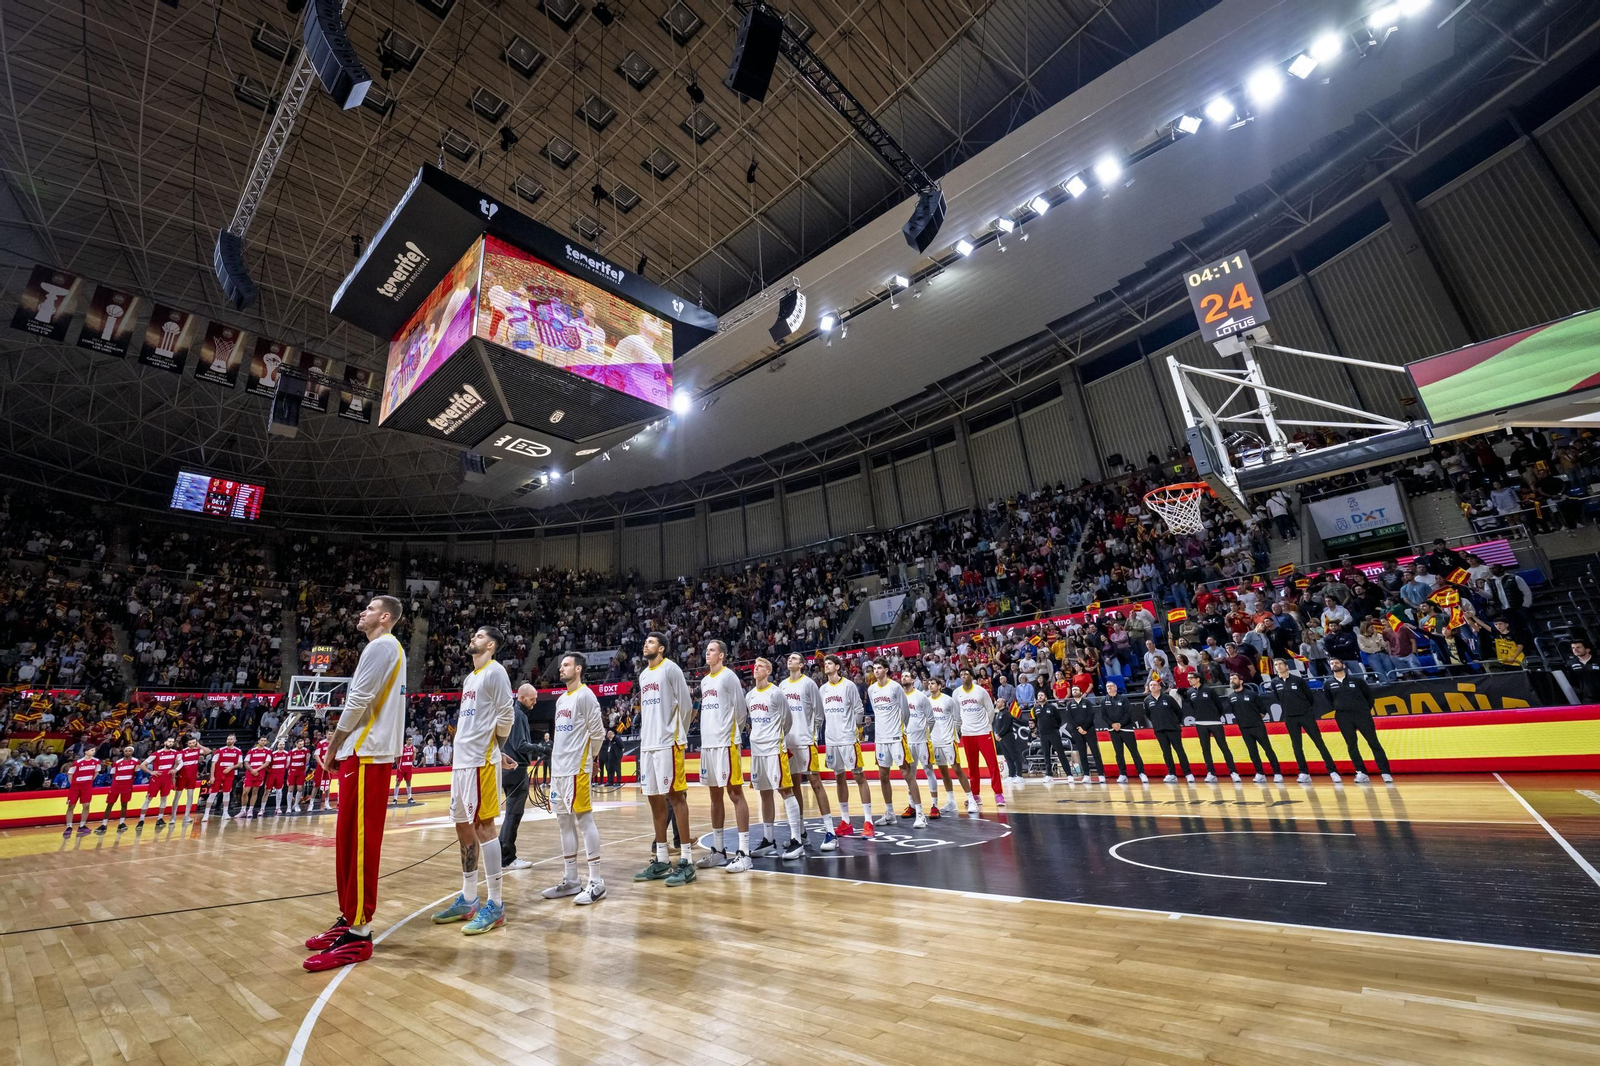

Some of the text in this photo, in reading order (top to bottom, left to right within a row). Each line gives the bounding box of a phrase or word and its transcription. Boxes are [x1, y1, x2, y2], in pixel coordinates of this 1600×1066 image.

[376, 241, 430, 298] tenerife!
[565, 244, 625, 285] tenerife!
[1188, 256, 1243, 287] 04:11
[1200, 282, 1254, 324] 24
[1216, 318, 1256, 338] LOTUS
[426, 383, 486, 432] tenerife!
[1351, 507, 1385, 524] DXT
[1355, 517, 1391, 530] TENERIFE
[1328, 537, 1348, 545] SALIDA
[316, 654, 330, 664] 24
[604, 684, 618, 692] DXT
[642, 682, 660, 695] ESPAÑA
[701, 688, 718, 700] ESPAÑA
[825, 695, 844, 704] ESPAÑA
[873, 695, 891, 704] ESPAÑA
[961, 698, 978, 706] ESPAÑA
[750, 703, 769, 713] ESPAÑA
